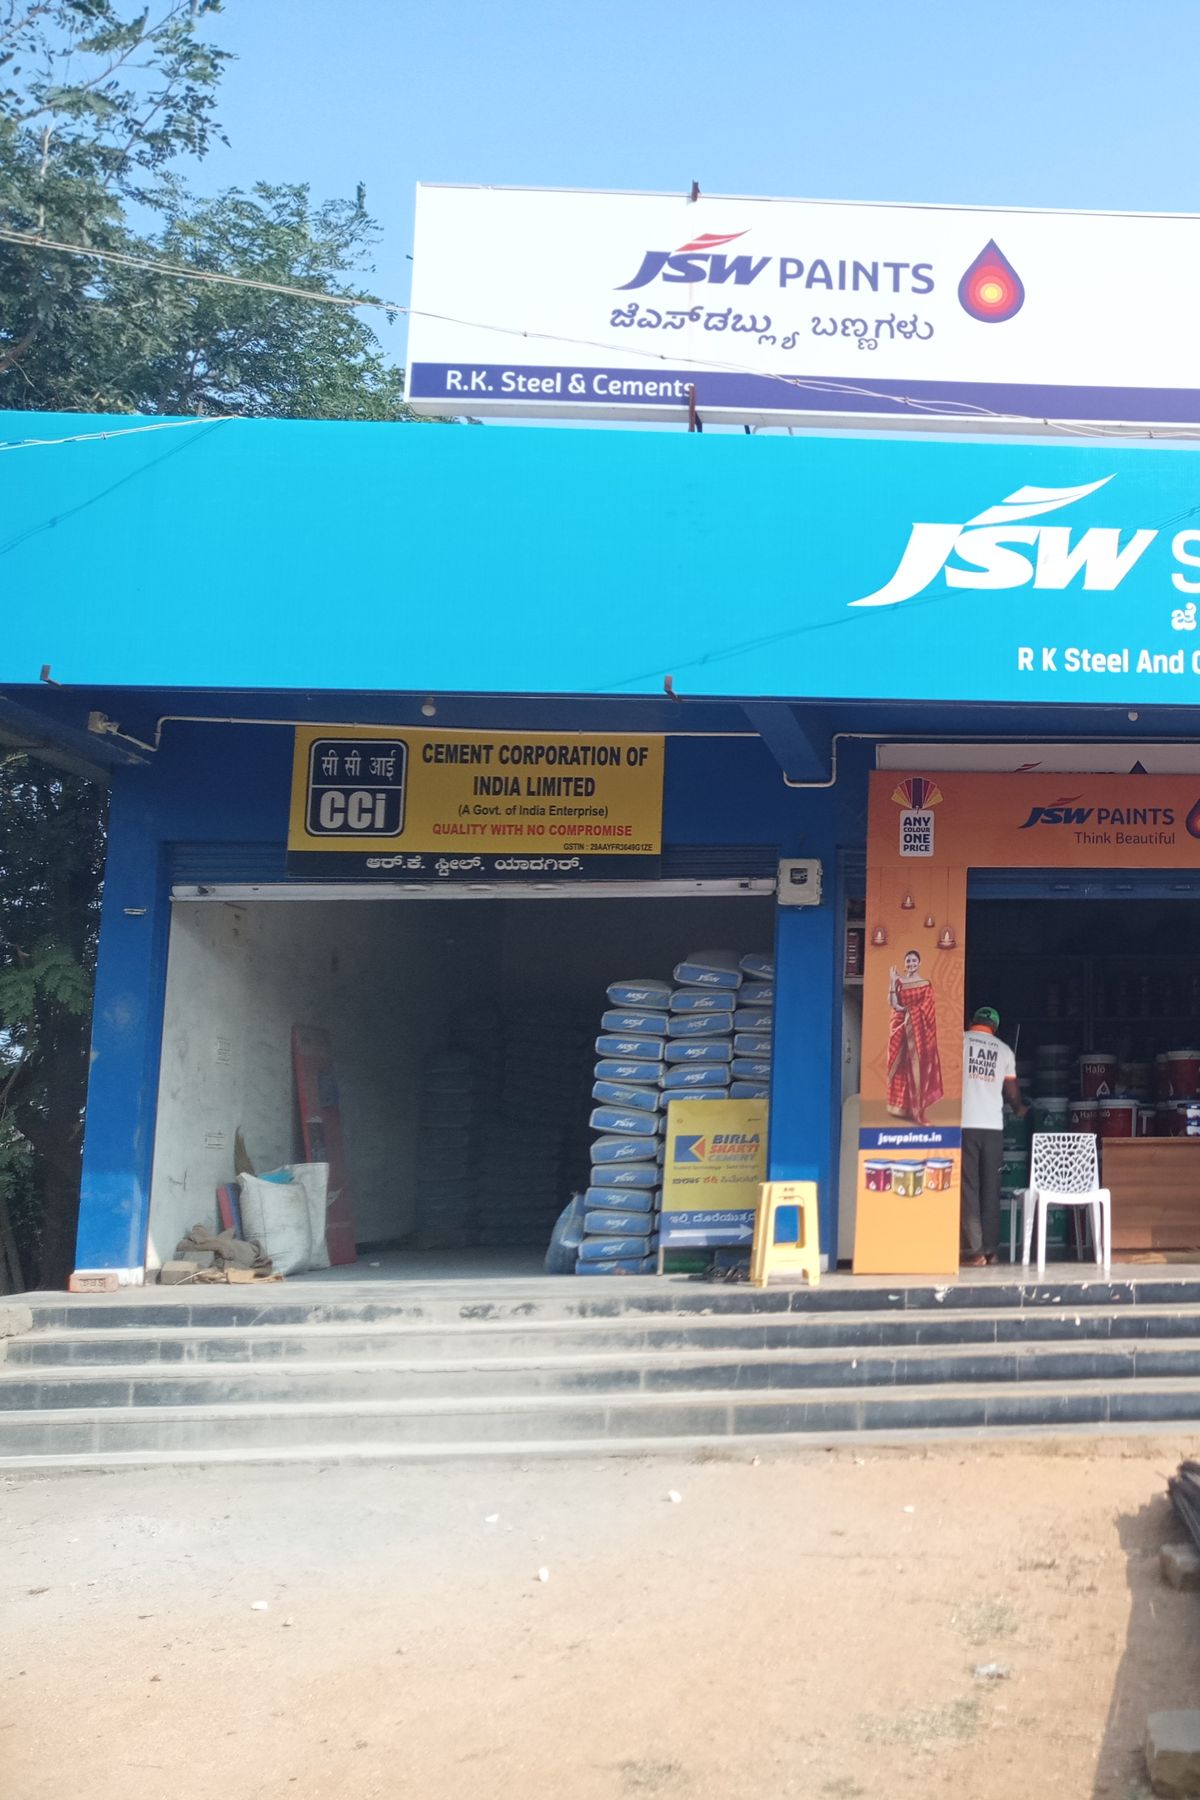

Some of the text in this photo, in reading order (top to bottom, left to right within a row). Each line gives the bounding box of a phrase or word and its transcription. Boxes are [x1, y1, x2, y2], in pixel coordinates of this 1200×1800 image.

[611, 249, 936, 295] JSW PAINTS
[810, 312, 935, 351] ಬಣ್ಣಗಳು
[446, 369, 695, 398] R.K. Steel & Cements
[846, 517, 1160, 608] JSW
[1171, 602, 1198, 632] ಜೆ
[1017, 646, 1034, 672] R
[1041, 647, 1059, 672] K
[1064, 648, 1129, 673] Steel
[1135, 648, 1185, 675] And
[422, 743, 649, 767] CEMENT CORPORATION OF
[321, 749, 397, 781] सी सी आई
[473, 775, 596, 797] INDIA LIMITED
[458, 804, 609, 819] (A Govt. of India Enterprise)
[1017, 805, 1175, 829] JSW PAINTS
[903, 816, 931, 827] ANY
[432, 823, 633, 838] QUALITY WITH NO COMPROMISE
[903, 833, 931, 844] ONE
[1074, 830, 1176, 845] Think Beautiful
[903, 844, 931, 852] PRICE
[969, 1045, 999, 1062] I AM
[968, 1057, 997, 1069] MAKING
[968, 1064, 996, 1077] INDIA
[712, 1133, 761, 1145] BIRLA
[877, 1131, 943, 1146] jswpaints.in
